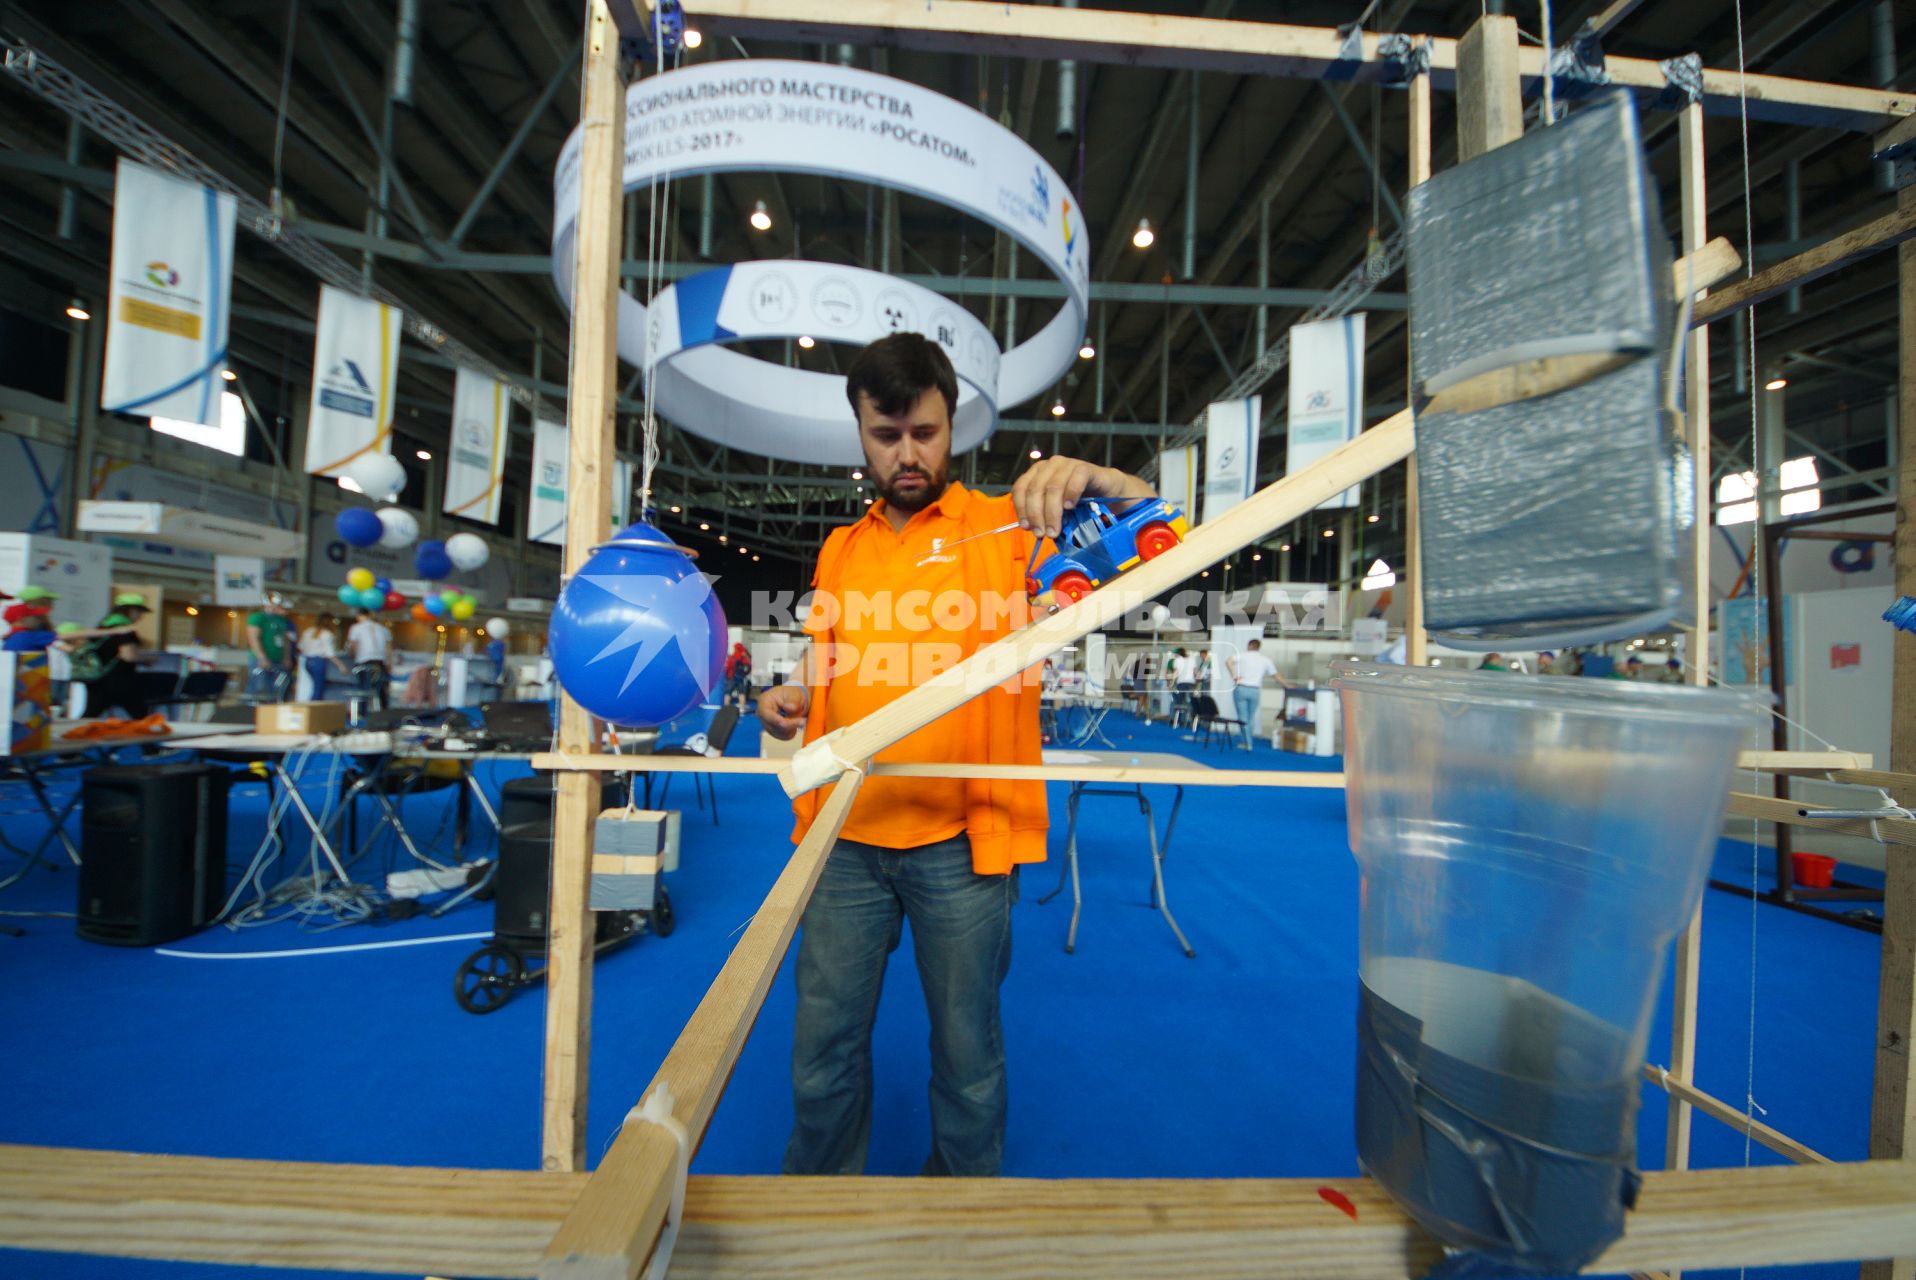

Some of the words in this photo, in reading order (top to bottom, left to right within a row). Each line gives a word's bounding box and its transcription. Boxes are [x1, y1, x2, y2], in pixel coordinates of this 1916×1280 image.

[628, 78, 775, 119] ССИОНАЛЬНОГО
[779, 77, 914, 119] МАСТЕРСТВА
[679, 103, 772, 128] АТОМНОЙ
[778, 103, 866, 132] ЭНЕРГИИ
[870, 119, 976, 168] «РОСАТОМ»
